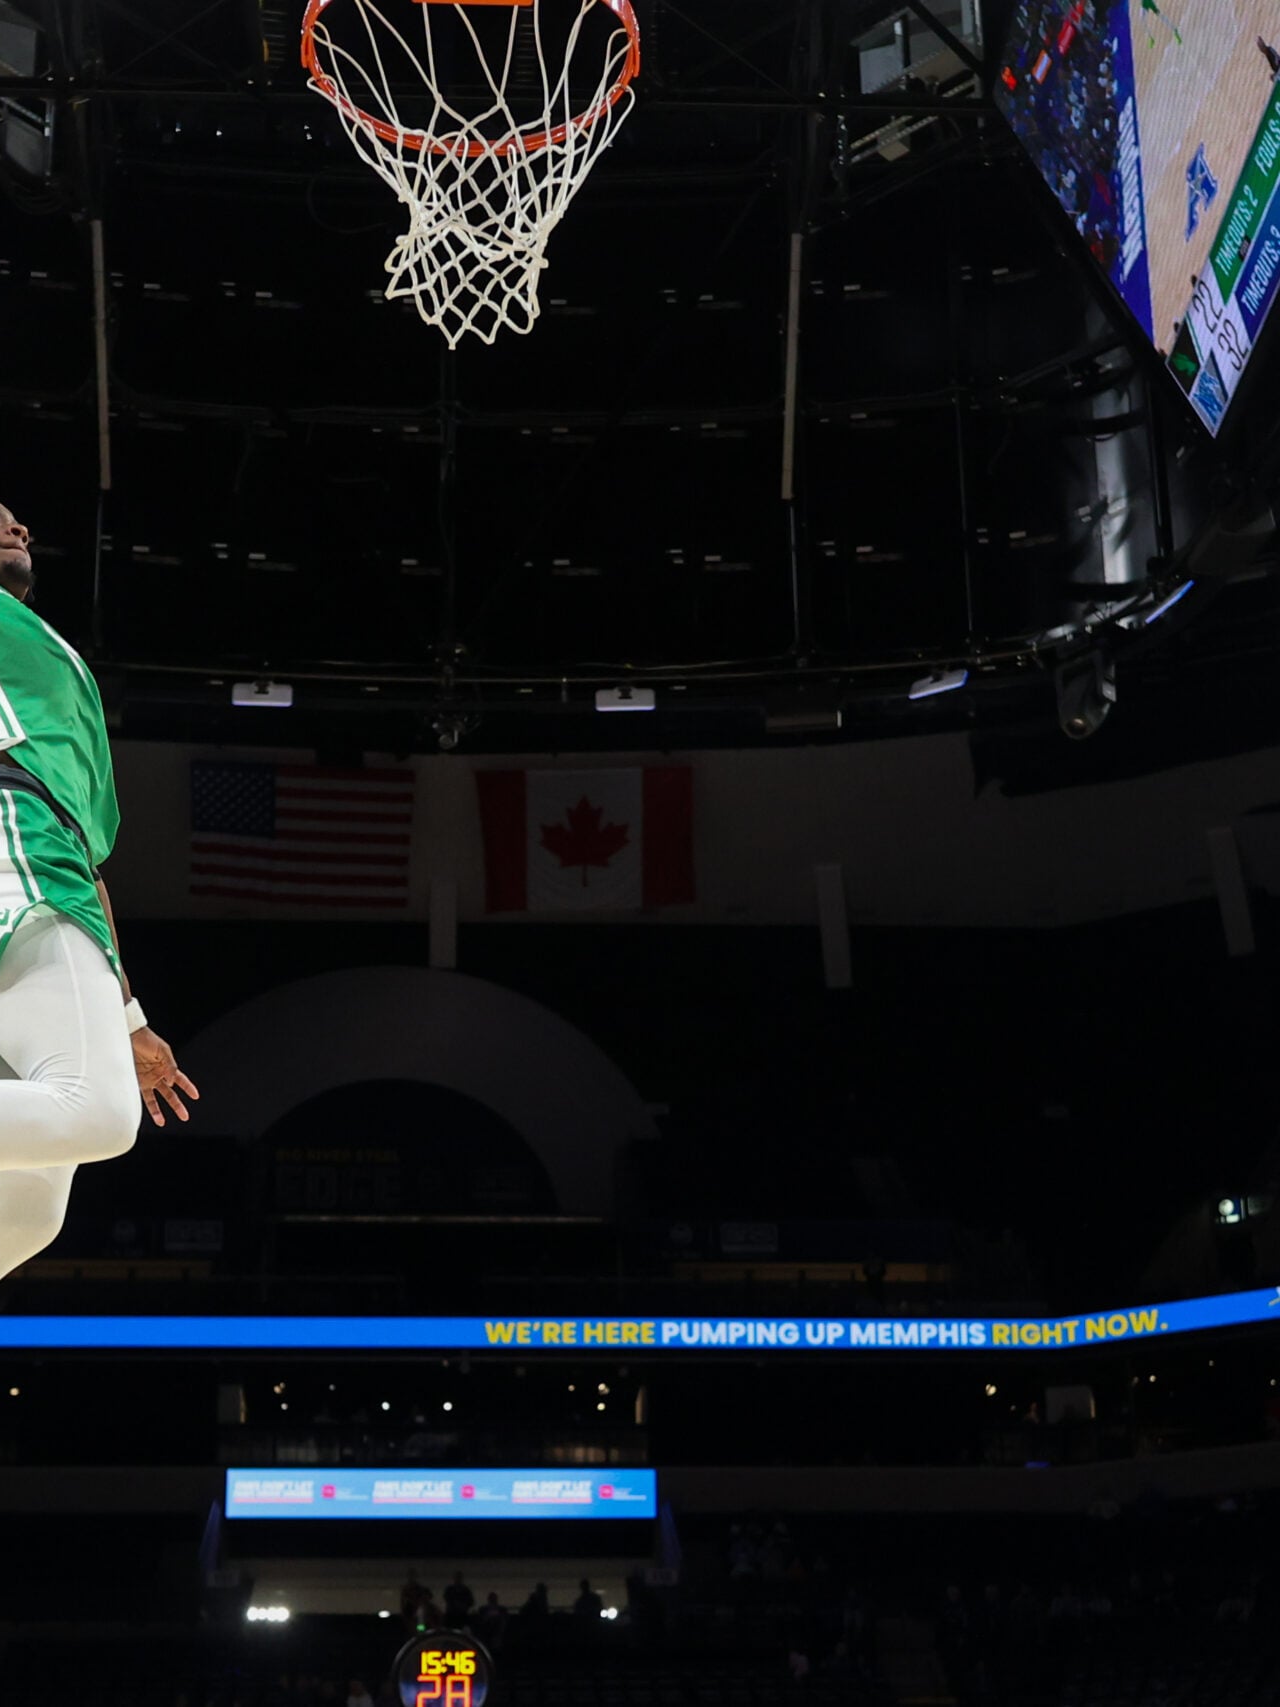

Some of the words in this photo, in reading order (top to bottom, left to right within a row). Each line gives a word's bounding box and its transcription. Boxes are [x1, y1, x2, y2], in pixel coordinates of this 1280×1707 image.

[1215, 200, 1254, 276] TIMEOUTS:
[1243, 184, 1258, 207] 2
[1192, 280, 1223, 333] 22
[1218, 319, 1249, 371] 32
[484, 1321, 577, 1345] WE'RE
[583, 1321, 655, 1345] HERE
[661, 1322, 800, 1346] PUMPING
[805, 1322, 844, 1346] UP
[850, 1322, 986, 1346] MEMPHIS
[992, 1320, 1079, 1346] RIGHT
[1084, 1308, 1169, 1341] NOW.
[421, 1650, 476, 1675] 15:46
